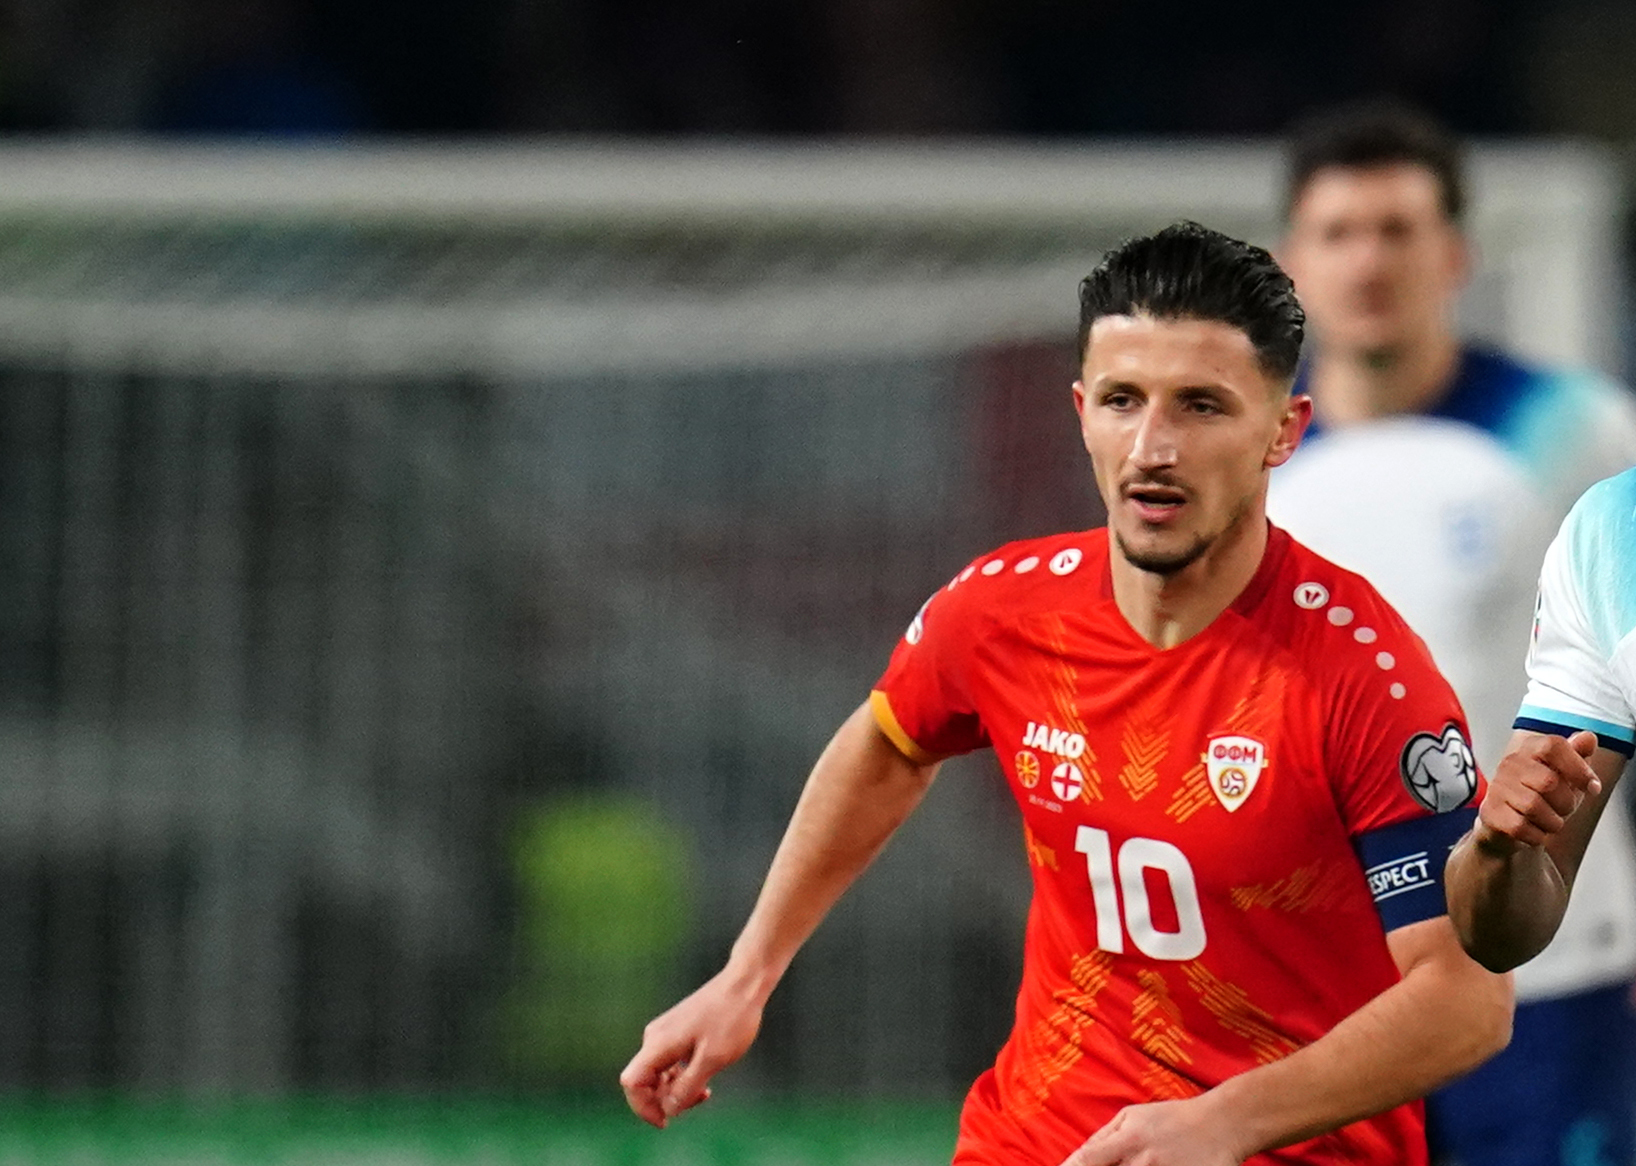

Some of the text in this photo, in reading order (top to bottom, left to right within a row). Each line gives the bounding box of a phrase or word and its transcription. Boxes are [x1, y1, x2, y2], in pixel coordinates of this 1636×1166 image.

[1022, 721, 1086, 759] JAKO
[1074, 825, 1207, 961] 10
[1367, 859, 1429, 894] ESPECT
